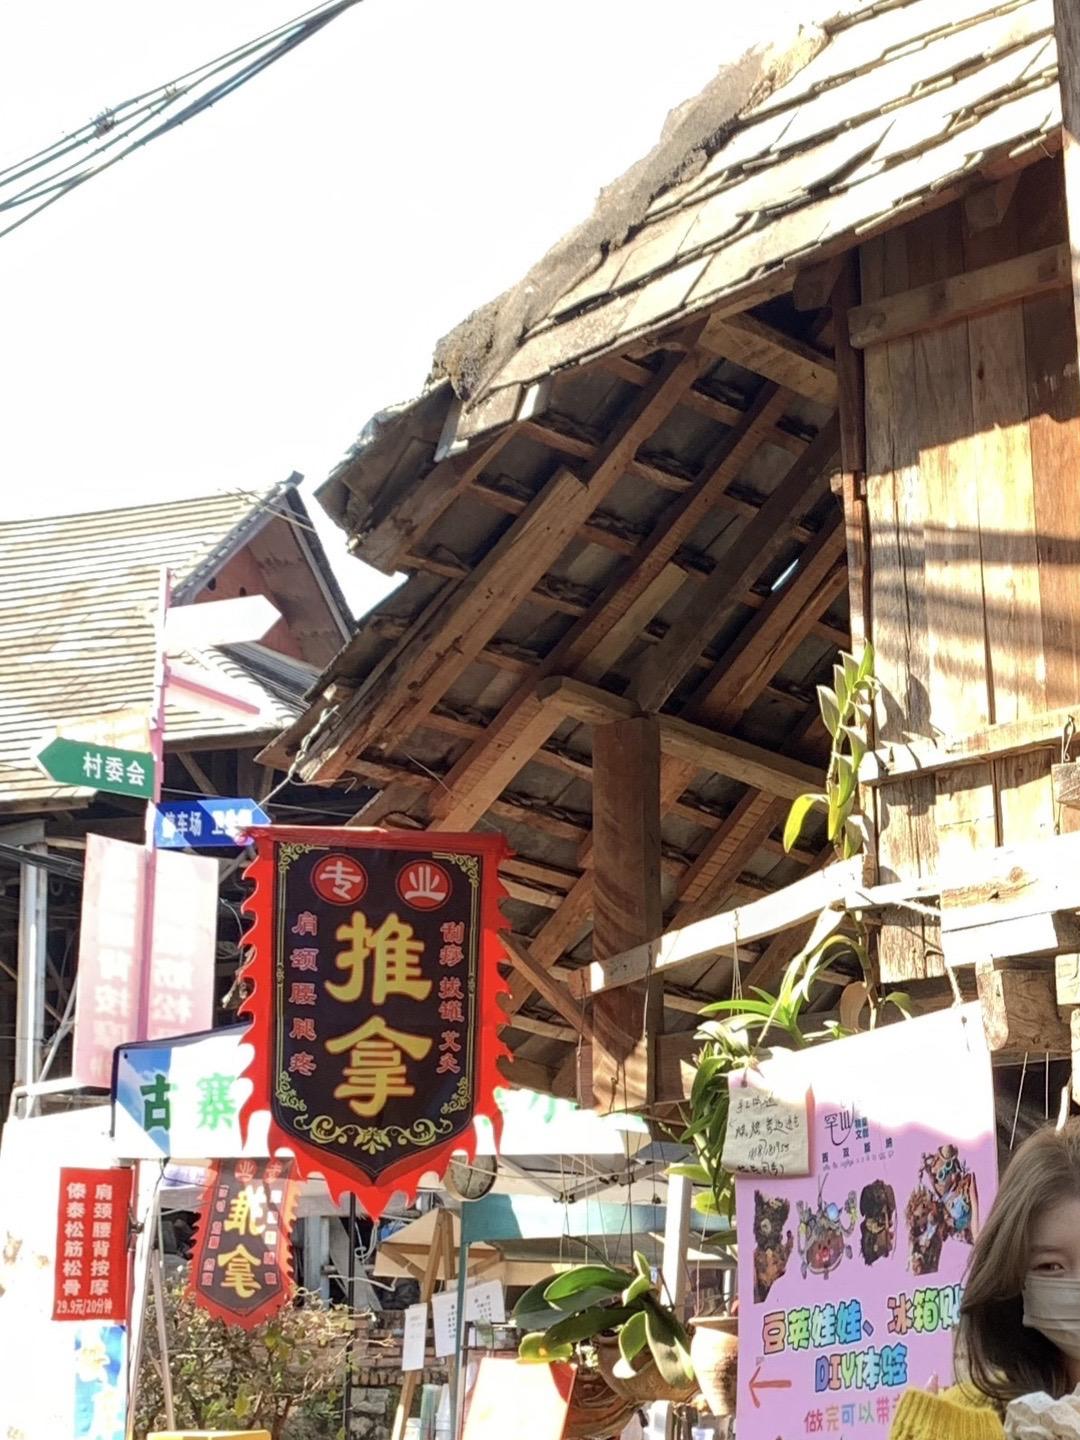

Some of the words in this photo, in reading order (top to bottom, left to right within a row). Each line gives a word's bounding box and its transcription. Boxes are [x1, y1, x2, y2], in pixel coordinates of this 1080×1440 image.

[82, 751, 145, 786] 村委会
[319, 860, 446, 900] 专业
[288, 911, 318, 1076] 肩颈腰腿疼
[324, 910, 433, 1117] 推拿
[89, 1183, 113, 1297] 肩颈腰背按摩
[815, 1342, 908, 1393] DIY体验
[804, 1395, 899, 1434] 做完可以带
